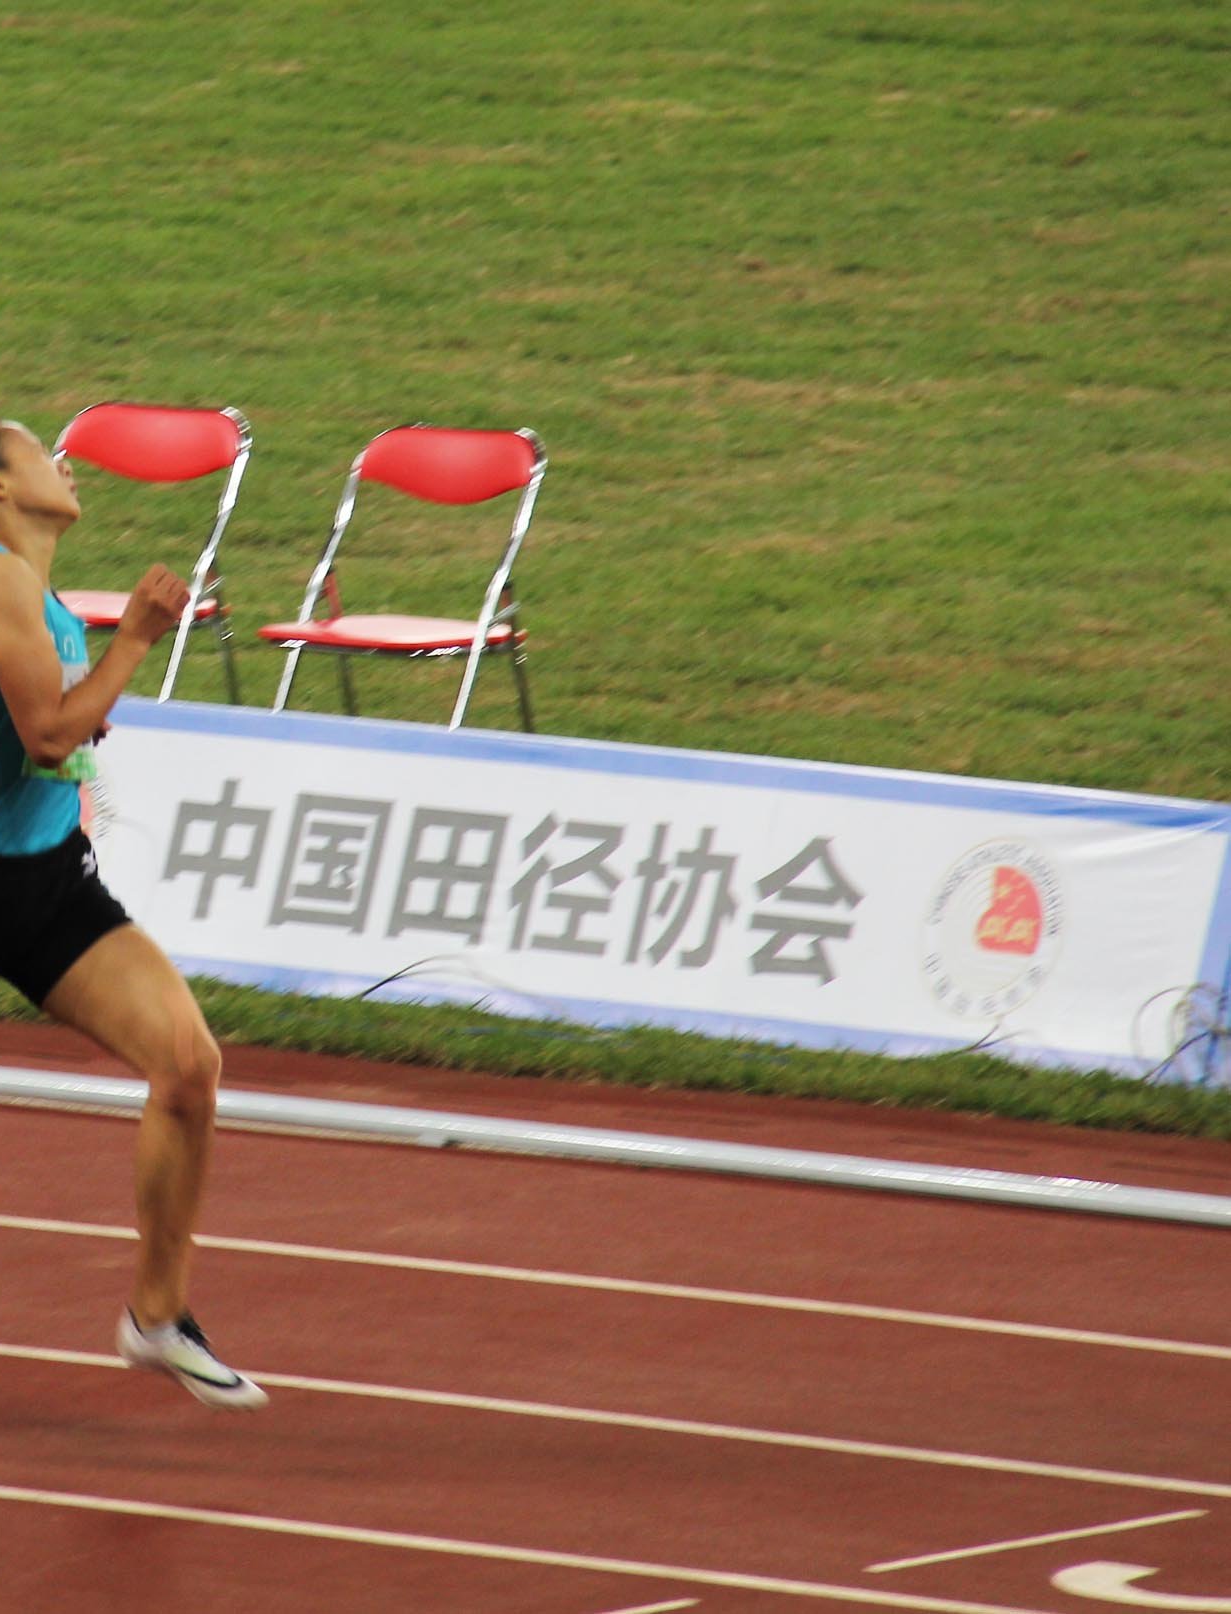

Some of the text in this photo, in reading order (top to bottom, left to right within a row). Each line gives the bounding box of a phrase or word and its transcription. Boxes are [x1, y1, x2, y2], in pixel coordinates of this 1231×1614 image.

[160, 778, 867, 987] 中国田径协会
